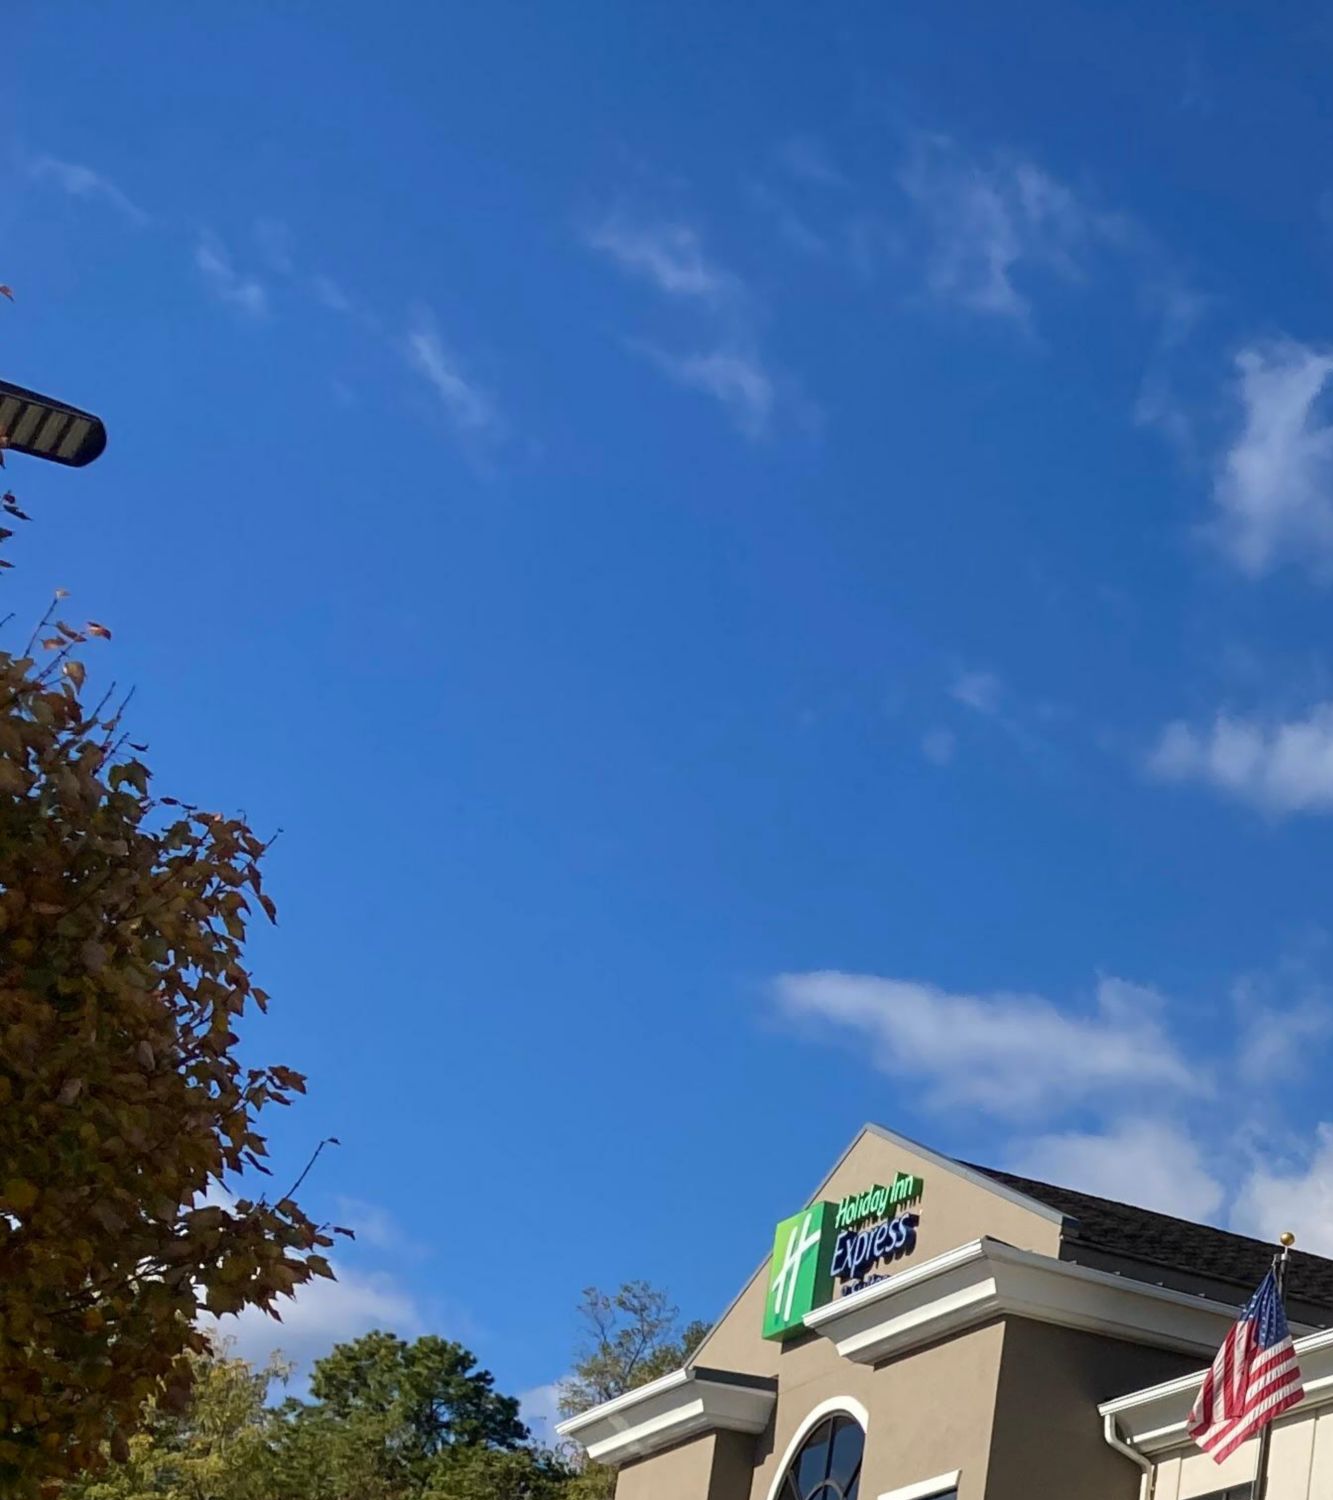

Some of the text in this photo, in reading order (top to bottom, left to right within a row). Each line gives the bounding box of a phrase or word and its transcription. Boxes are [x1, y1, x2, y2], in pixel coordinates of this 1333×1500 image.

[834, 1172, 914, 1229] Holiday Inn
[831, 1211, 910, 1279] Express
